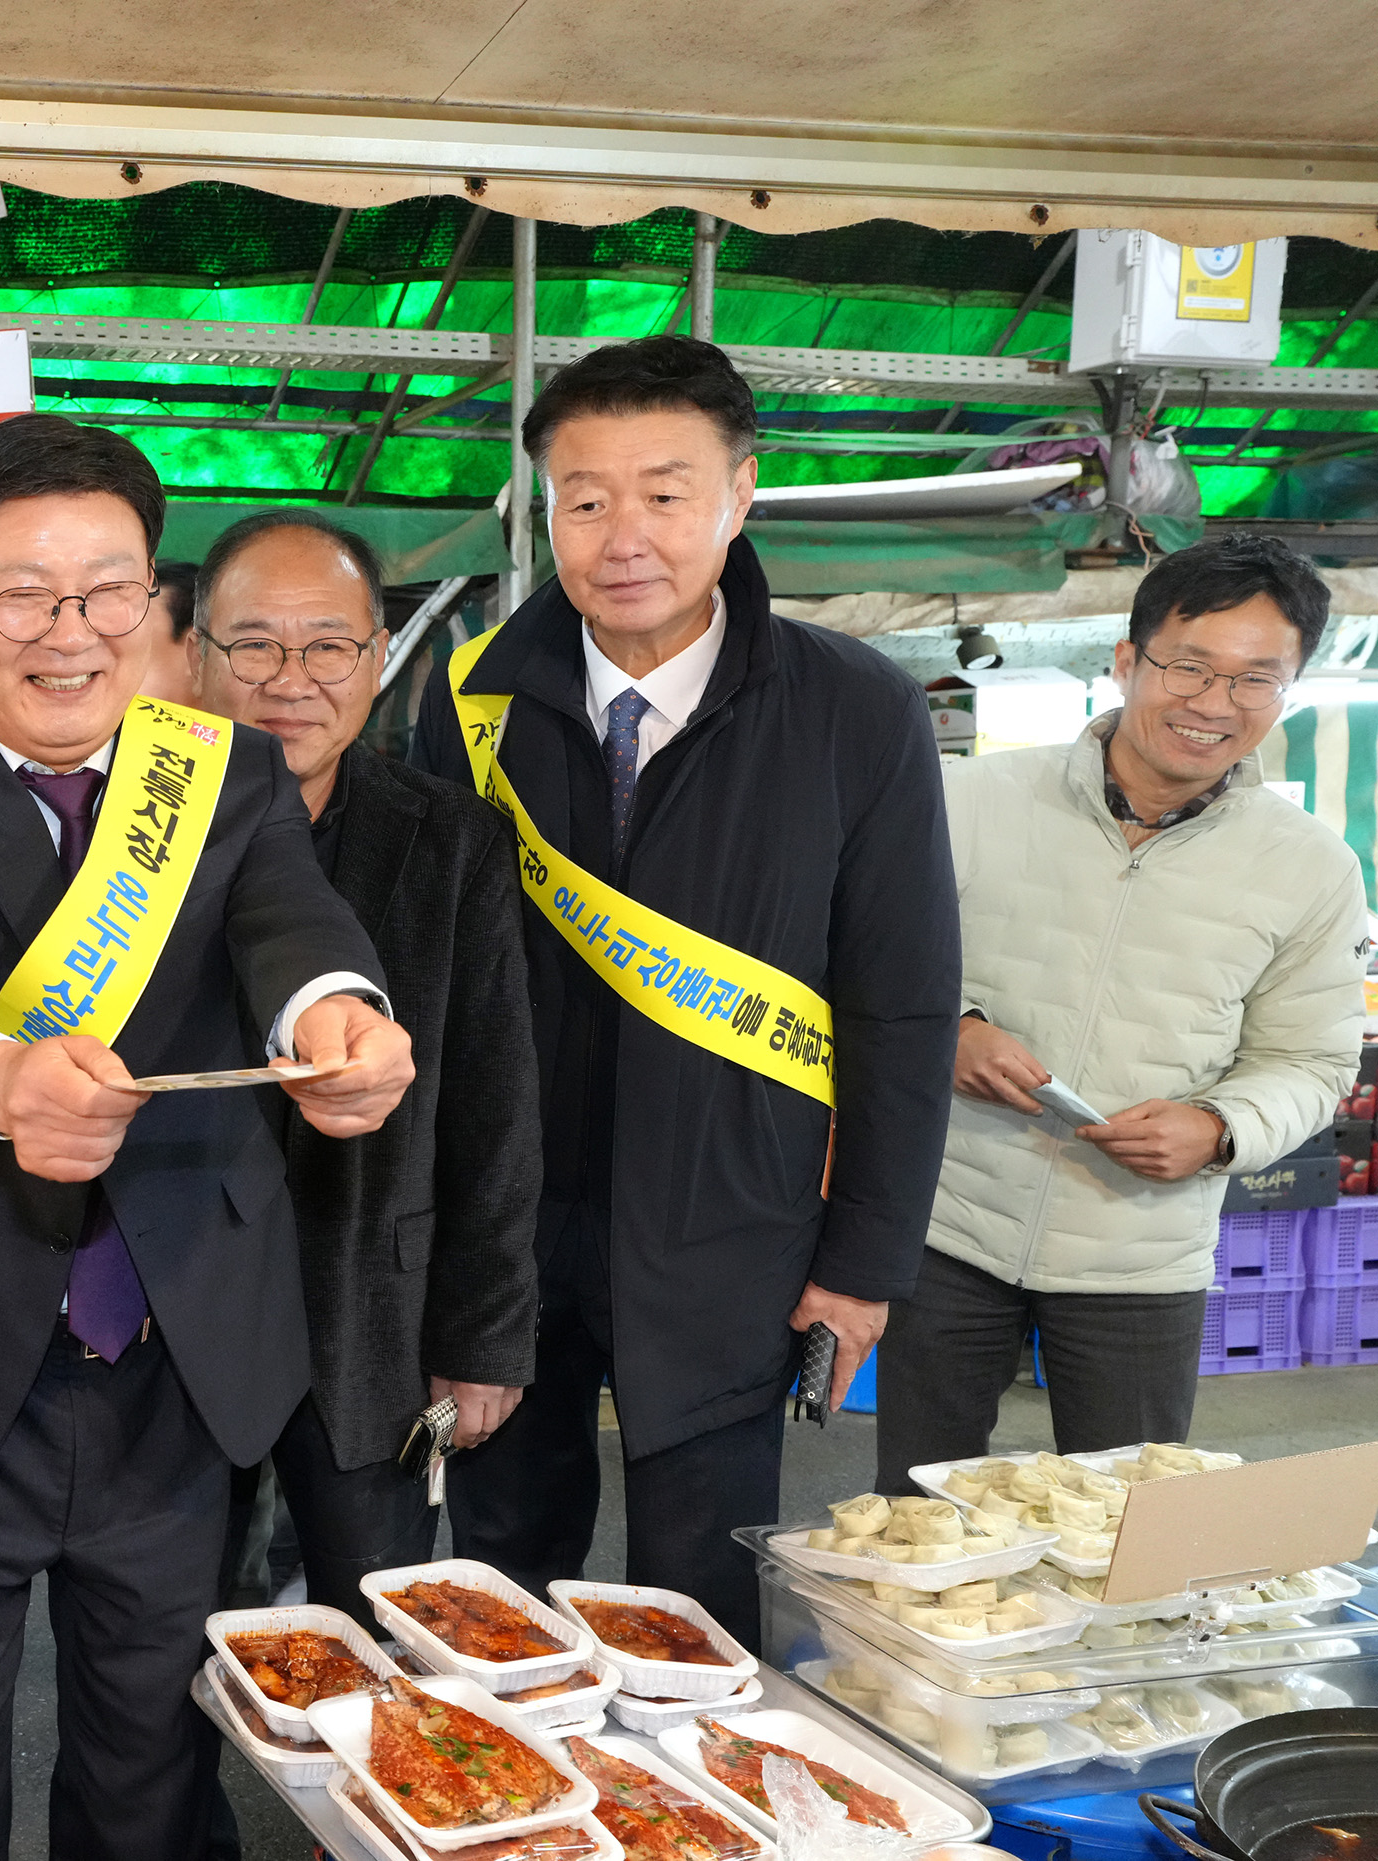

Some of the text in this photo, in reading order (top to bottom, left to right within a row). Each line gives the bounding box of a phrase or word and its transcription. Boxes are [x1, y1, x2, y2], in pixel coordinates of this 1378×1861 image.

[12, 743, 196, 1045] 전통시장 온누리상품
[768, 1005, 836, 1086] 애용합시
